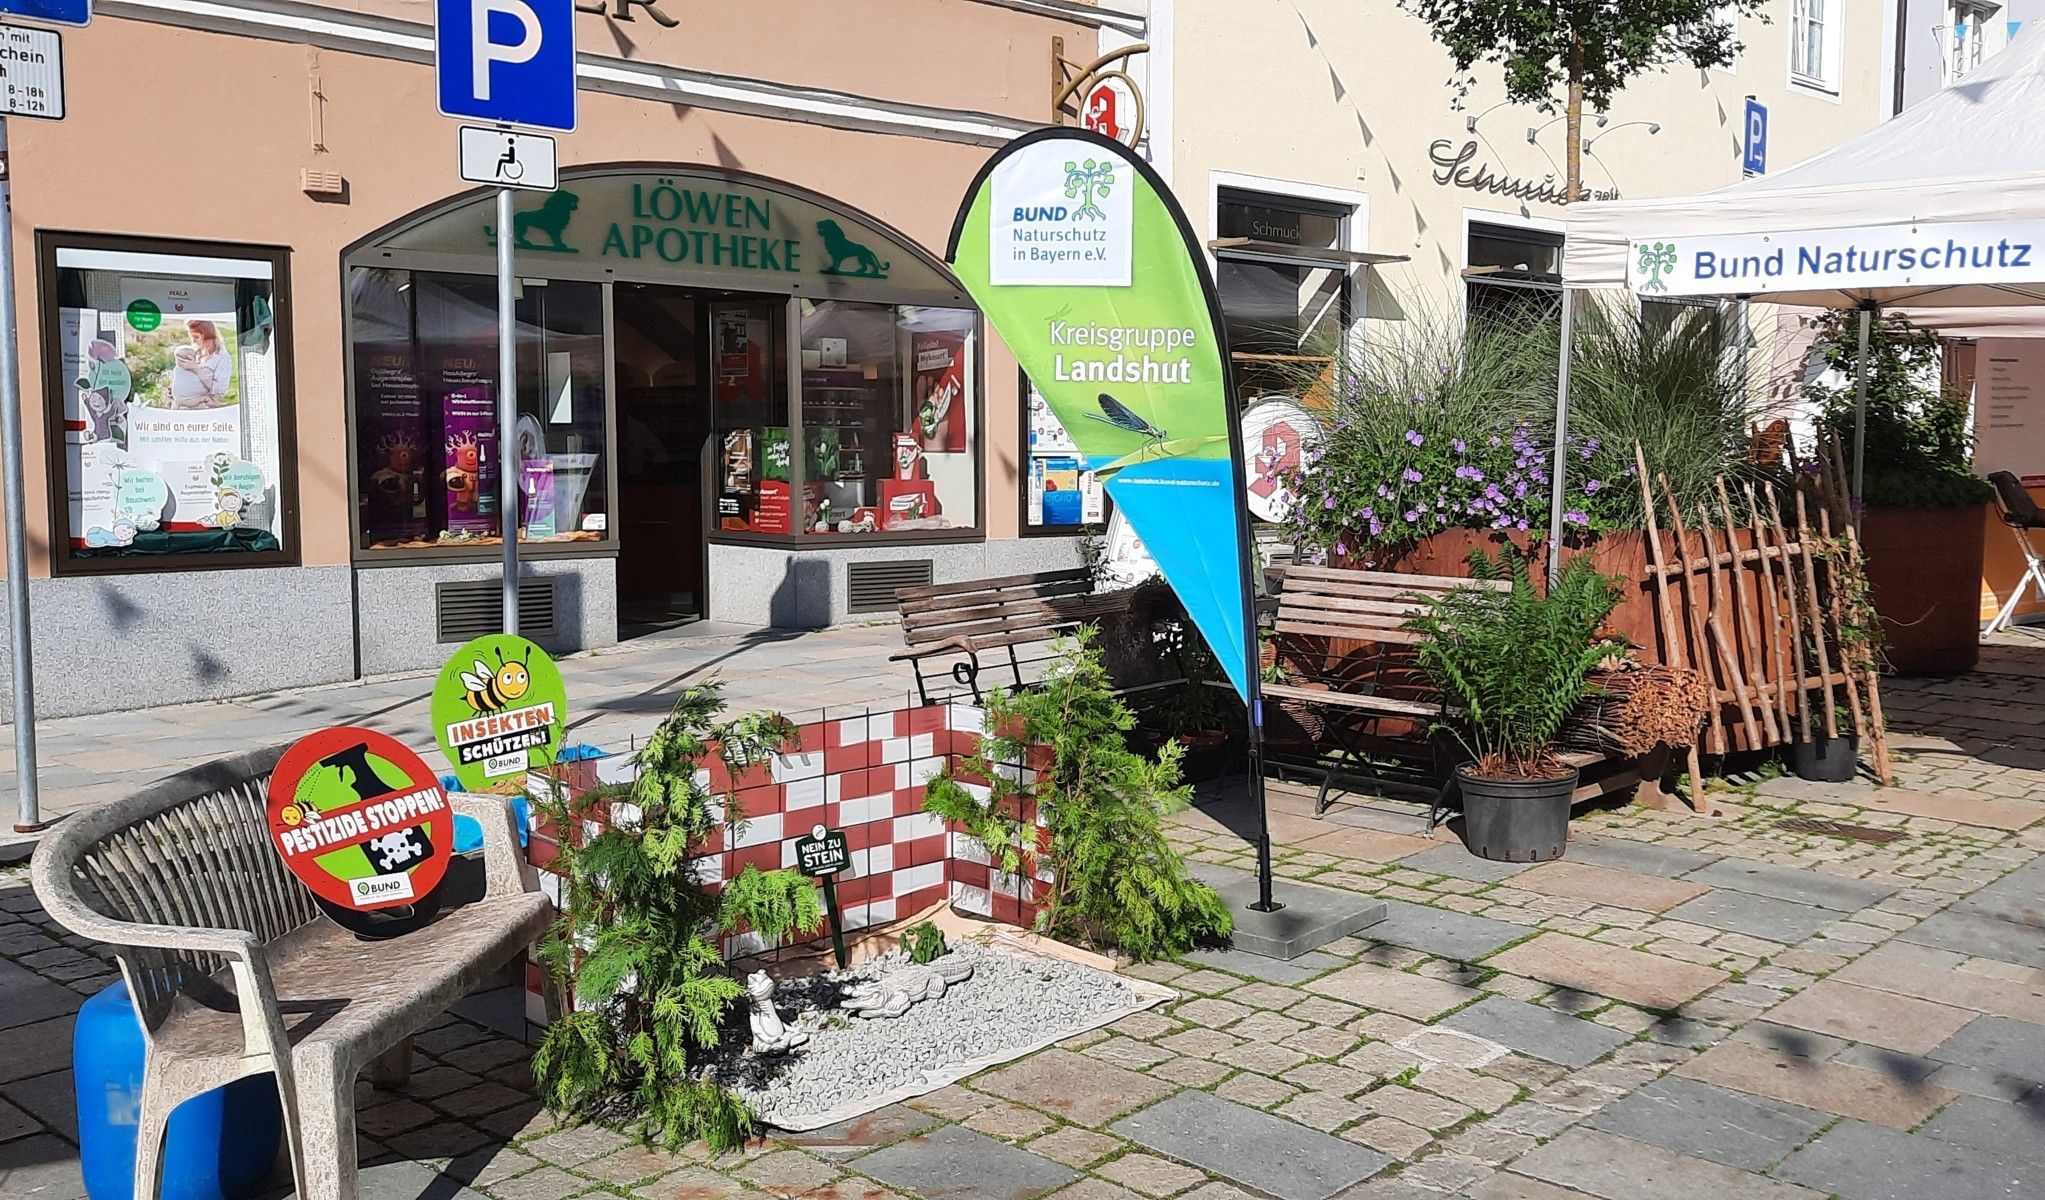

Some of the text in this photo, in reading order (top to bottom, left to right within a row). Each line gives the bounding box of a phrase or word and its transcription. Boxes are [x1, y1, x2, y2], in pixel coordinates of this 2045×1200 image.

[10, 33, 31, 43] mit
[471, 0, 543, 101] P
[1749, 110, 1763, 162] P
[633, 179, 771, 231] LÖWEN
[1013, 206, 1067, 222] BUND
[1012, 227, 1107, 242] Naturschutz
[1252, 220, 1302, 240] Schmuck
[602, 223, 801, 273] APOTHEKE
[1013, 246, 1107, 264] in Bayern e.V.
[1694, 237, 2033, 279] Bund Naturschutz
[1050, 321, 1196, 351] Kreisgruppe
[1054, 353, 1191, 384] Landshut
[135, 421, 150, 431] Wir
[153, 421, 170, 431] sind
[173, 423, 184, 431] an
[451, 706, 552, 743] INSEKTEN
[462, 731, 548, 762] SCHÜTZEN!
[498, 757, 521, 768] BUND
[280, 786, 446, 857] PESTIZIDE STOPPEN!
[801, 838, 842, 855] NEIN ZU
[804, 848, 844, 868] STEIN
[371, 881, 401, 893] BUND
